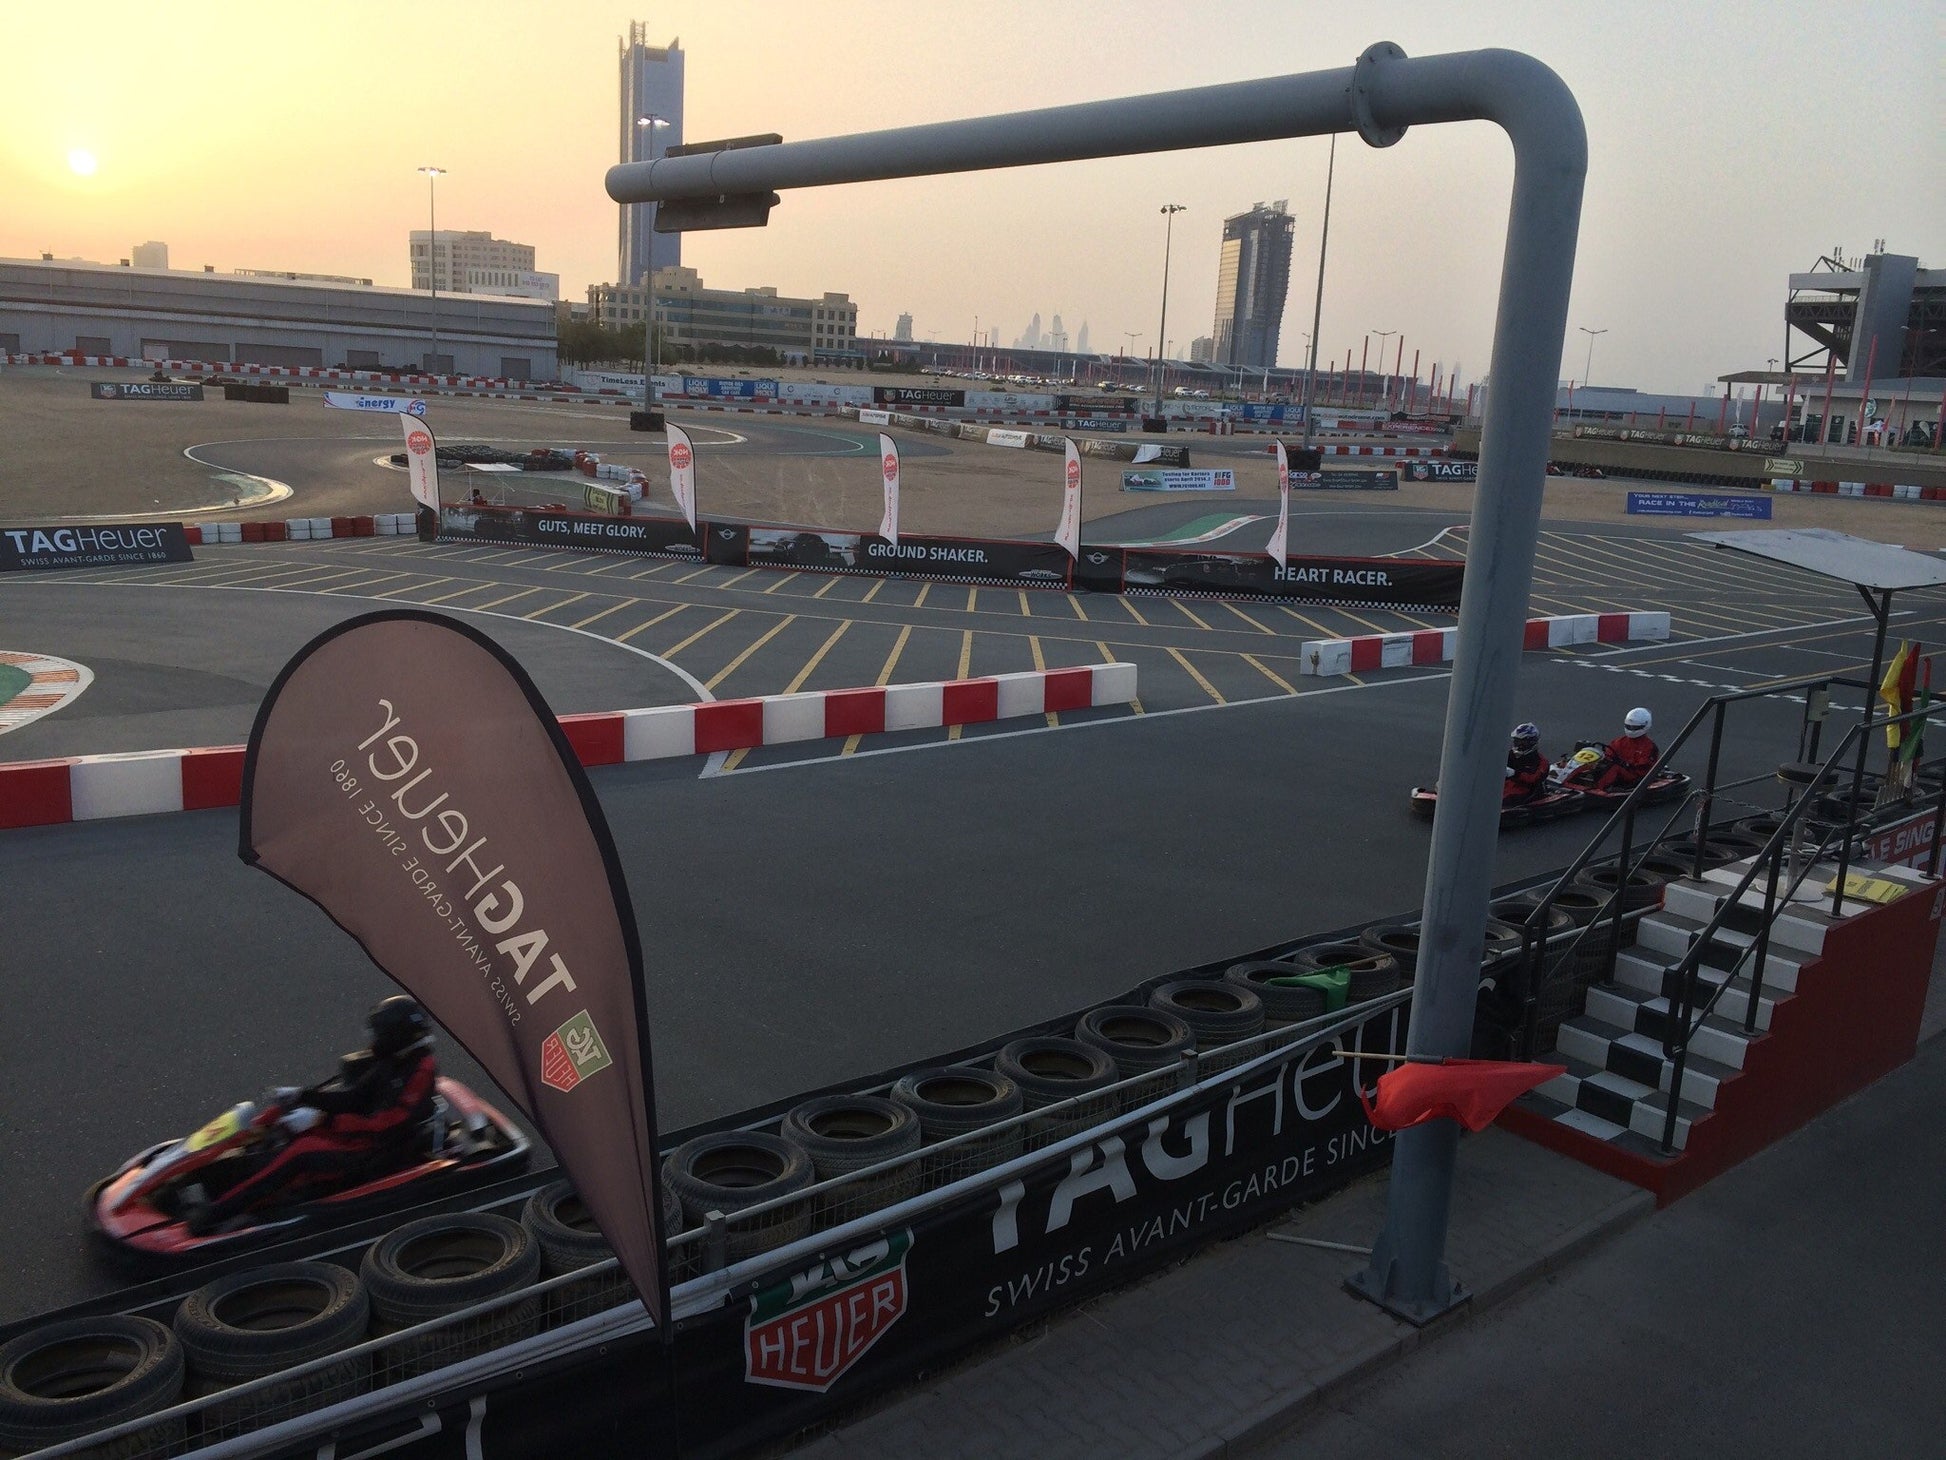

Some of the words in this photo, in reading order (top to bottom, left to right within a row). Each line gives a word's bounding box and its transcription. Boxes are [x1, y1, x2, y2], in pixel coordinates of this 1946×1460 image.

[538, 520, 570, 535] GUTS,
[574, 522, 604, 535] MEET
[606, 524, 647, 538] GLORY.
[20, 558, 50, 566] SWISS
[52, 554, 116, 564] AVANT-GARDE
[118, 552, 144, 561] SINCE
[868, 543, 926, 559] GROUND
[930, 547, 988, 563] SHAKER.
[1274, 566, 1329, 582] HEART
[1333, 569, 1392, 586] RACER.
[984, 1246, 1092, 1318] SWISS
[1104, 1147, 1315, 1265] AVANT-GARDE
[760, 1280, 896, 1378] HEUER
